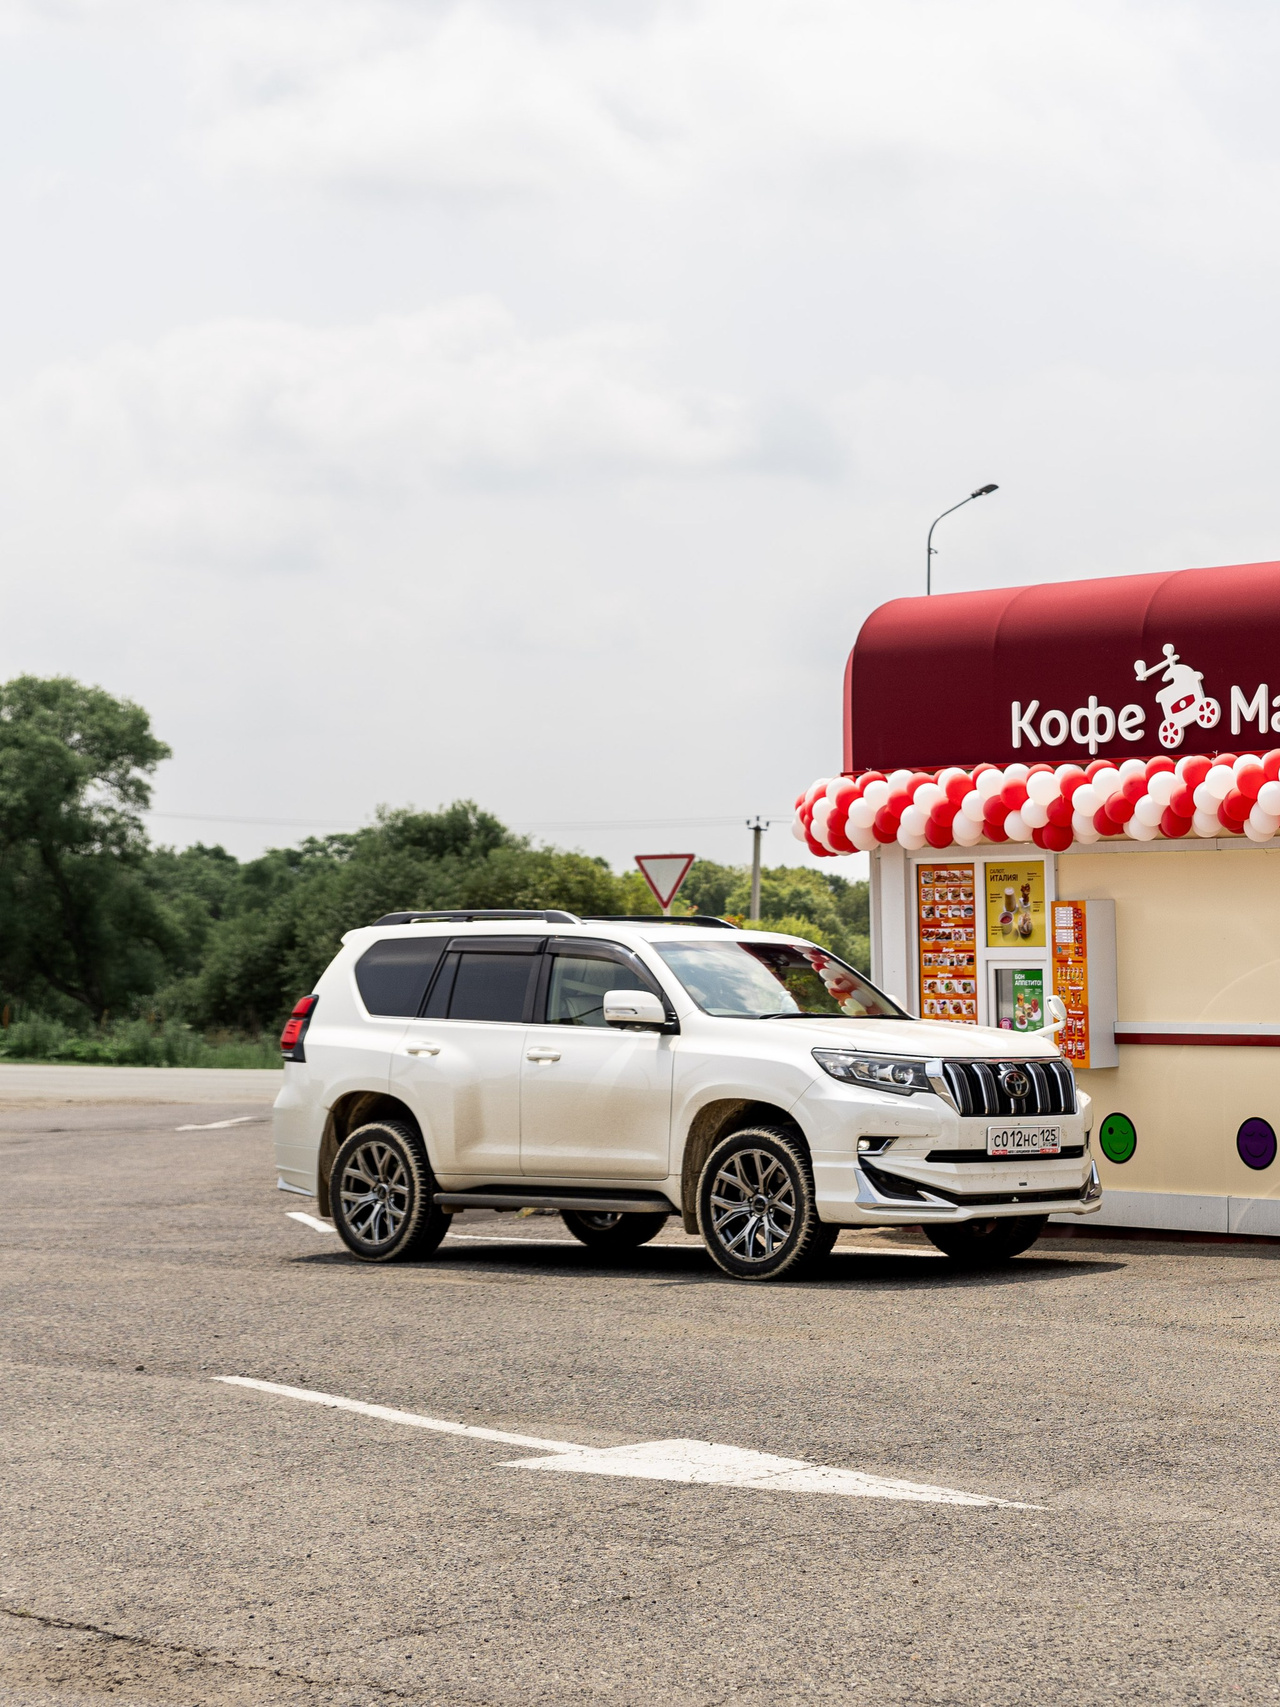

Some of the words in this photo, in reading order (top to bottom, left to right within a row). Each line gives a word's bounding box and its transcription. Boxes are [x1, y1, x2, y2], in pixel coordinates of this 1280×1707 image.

[1011, 695, 1146, 755] Кофе
[990, 874, 1018, 882] ИТАЛИЯ!
[1040, 1129, 1056, 1142] 125
